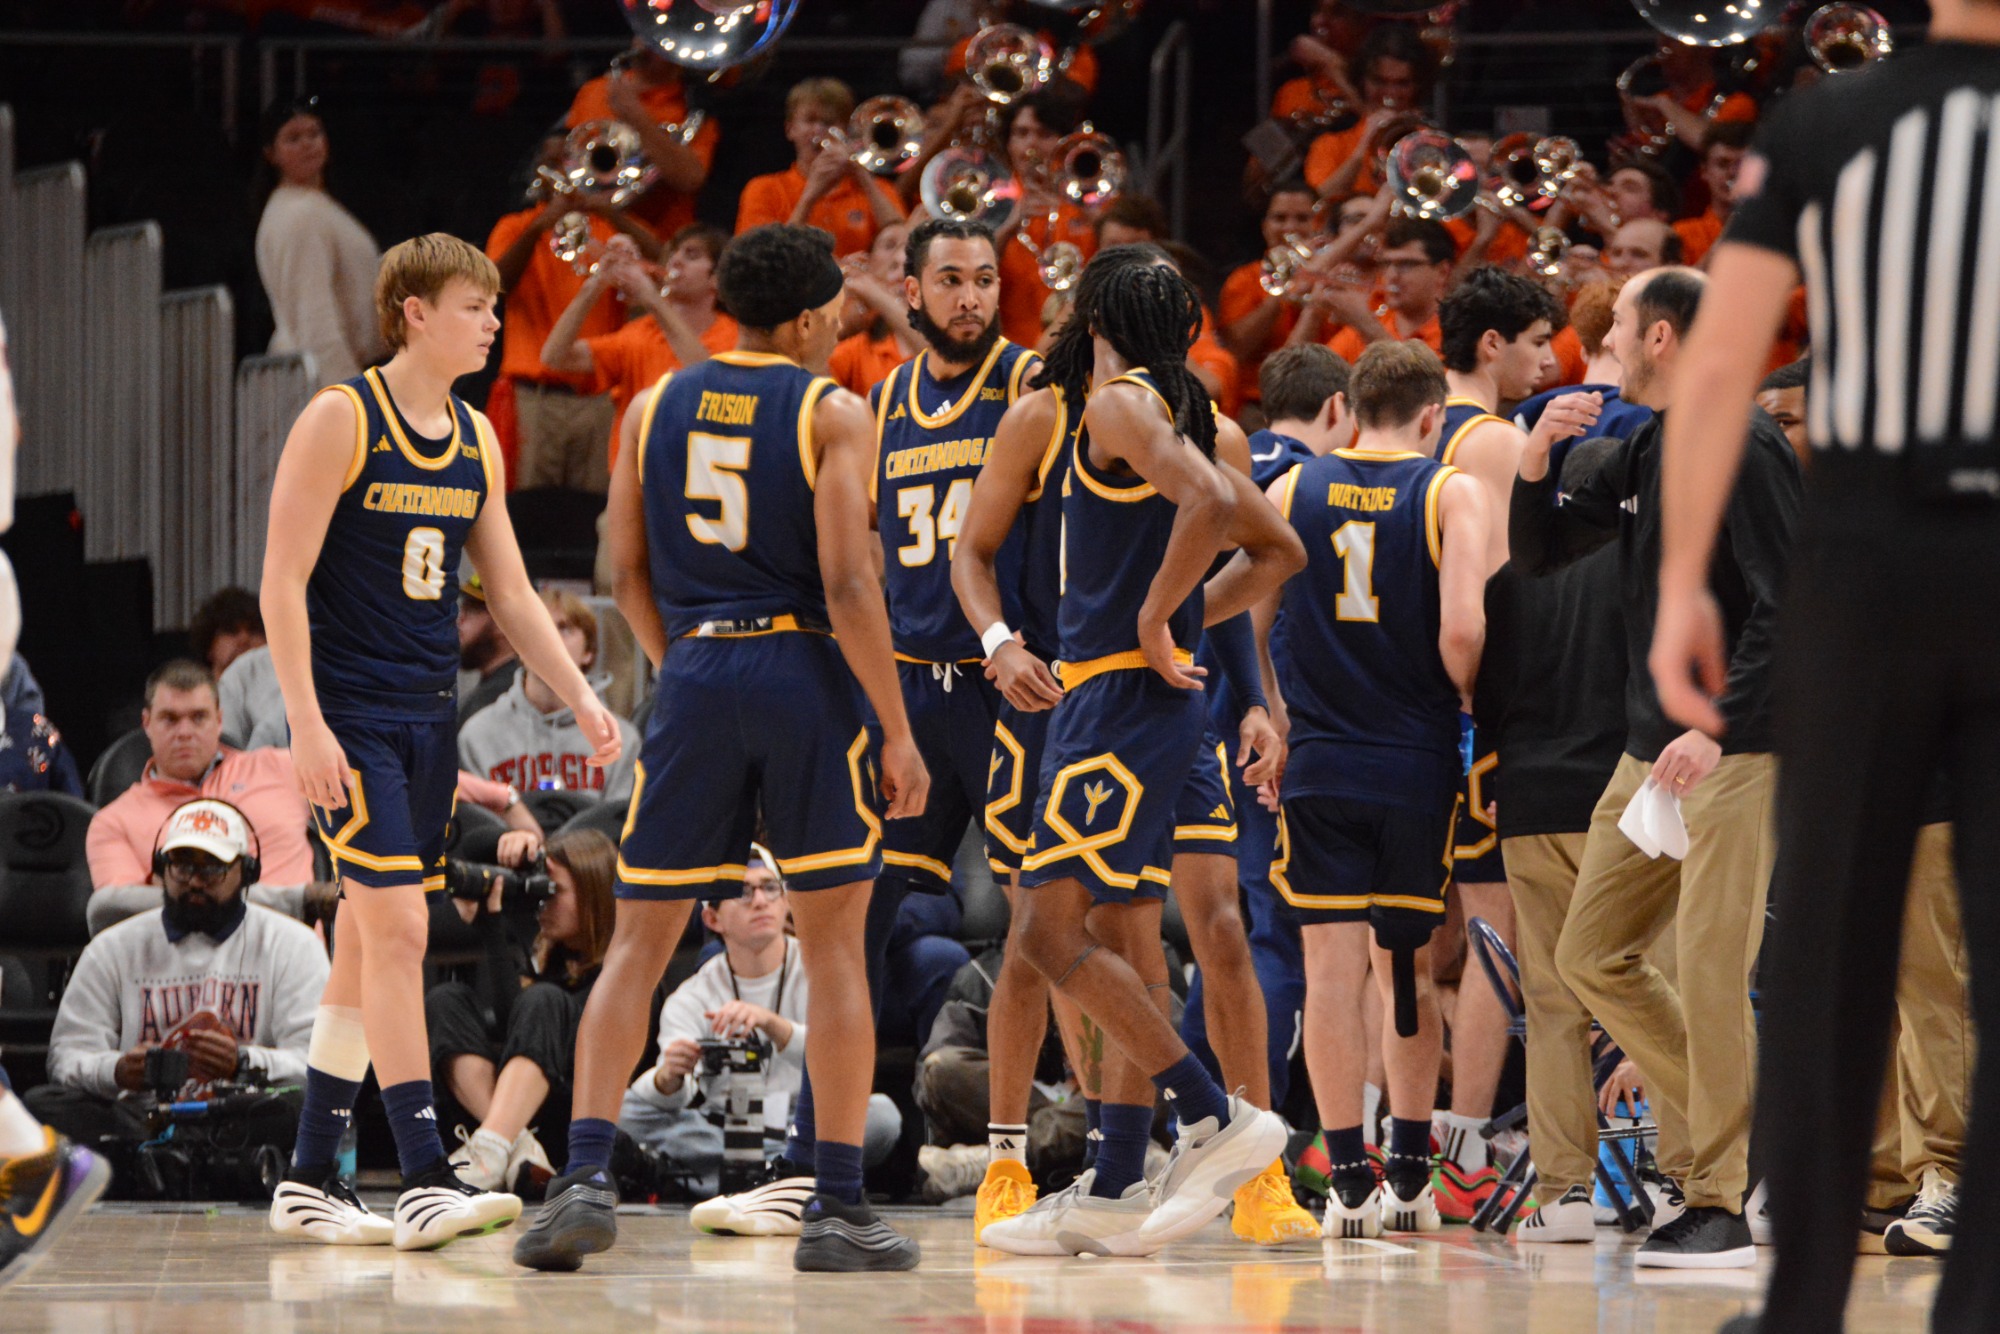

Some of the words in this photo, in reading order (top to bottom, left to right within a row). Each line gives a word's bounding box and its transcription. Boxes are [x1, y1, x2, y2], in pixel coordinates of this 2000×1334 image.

[696, 390, 759, 426] FRISON
[684, 431, 752, 552] 5
[897, 478, 974, 568] 34
[1327, 483, 1397, 512] WATKINS
[402, 526, 447, 600] 0
[1330, 519, 1380, 623] 1
